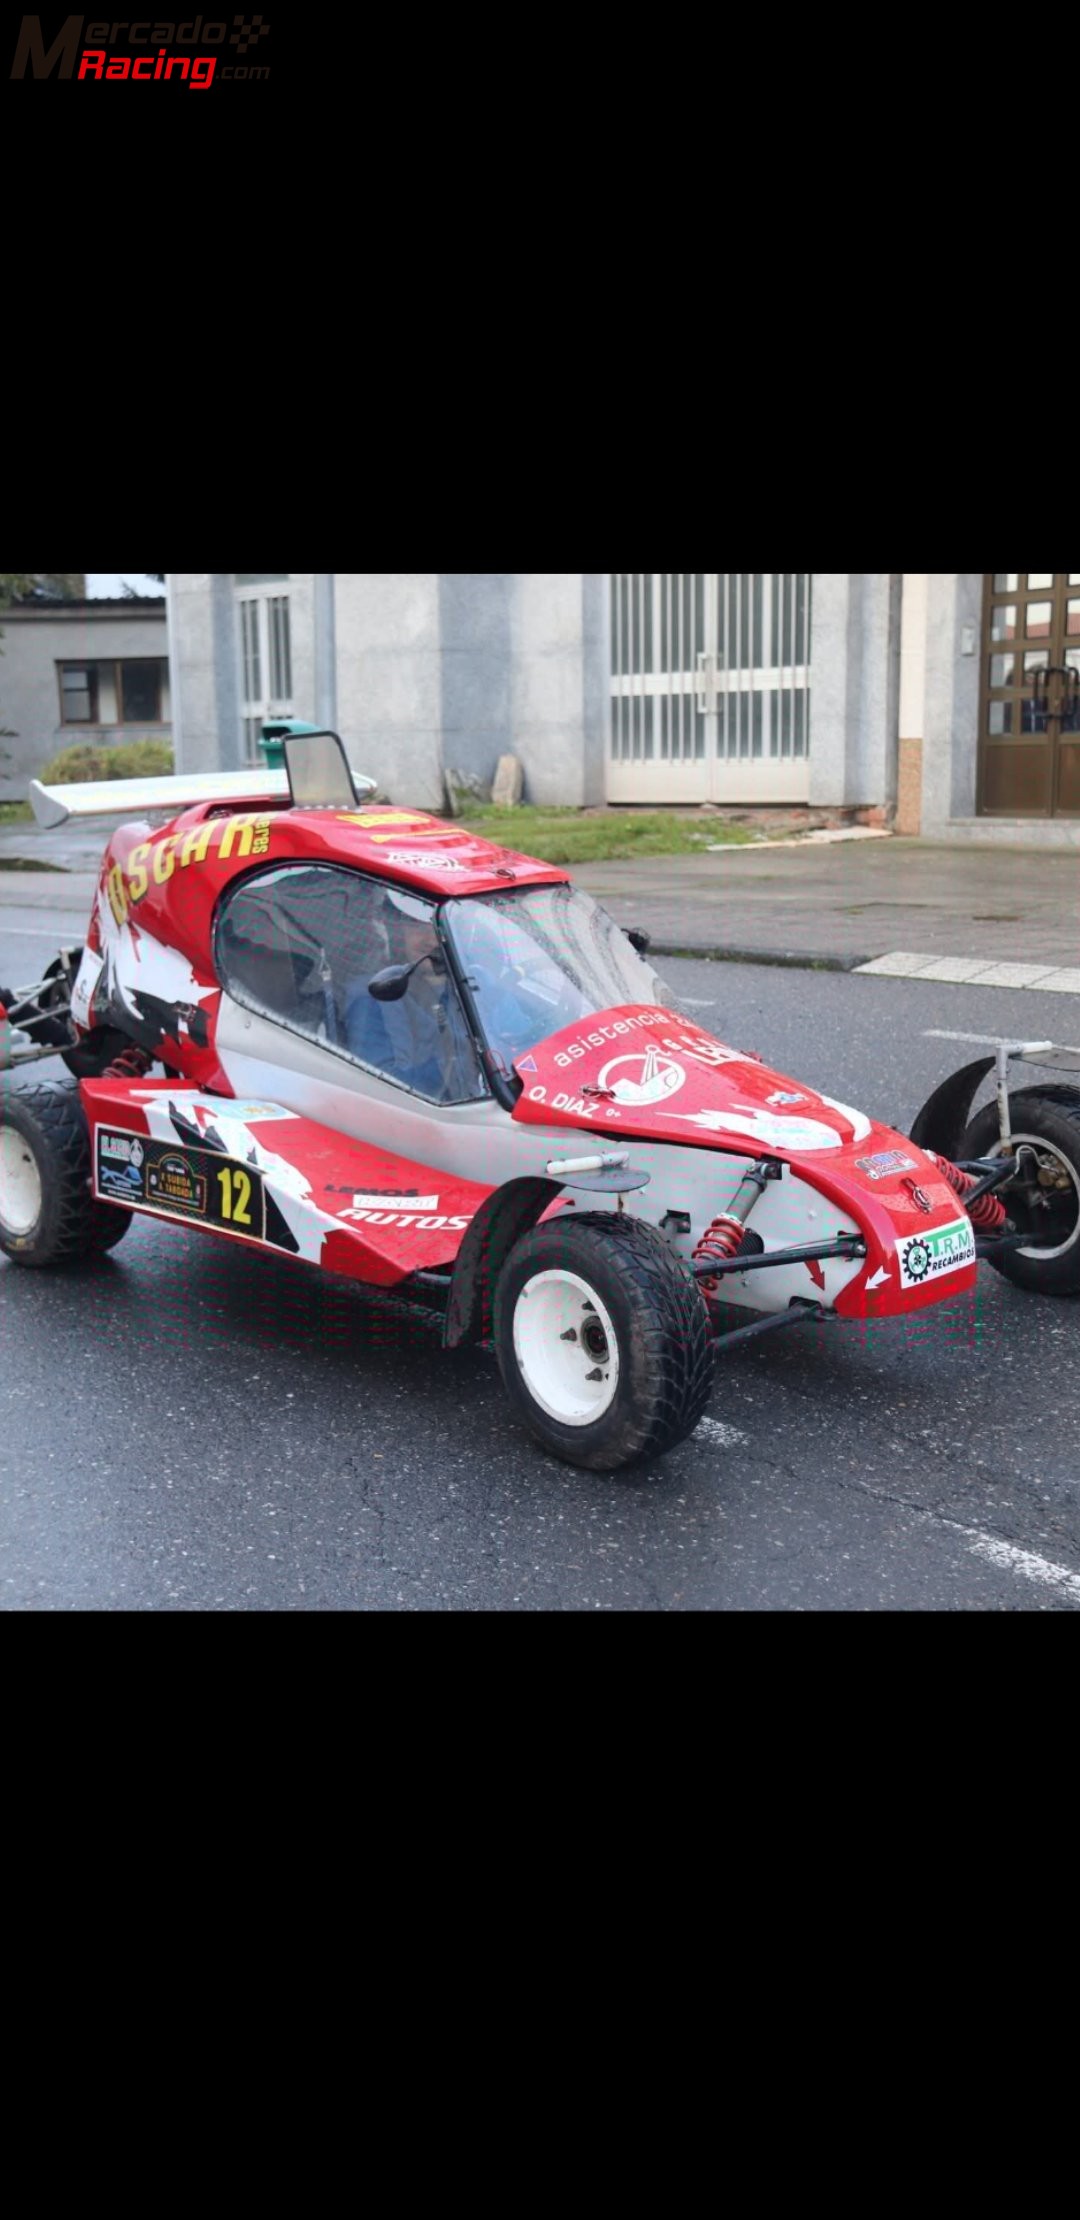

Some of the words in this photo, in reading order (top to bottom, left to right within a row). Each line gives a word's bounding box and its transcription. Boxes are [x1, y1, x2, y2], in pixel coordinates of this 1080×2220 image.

[554, 1011, 670, 1068] asistencia
[528, 1086, 547, 1104] O.
[217, 1167, 252, 1225] 12
[324, 1184, 420, 1198] LEMOS
[335, 1208, 475, 1230] AUTOS
[931, 1248, 975, 1272] RECAMBIOS
